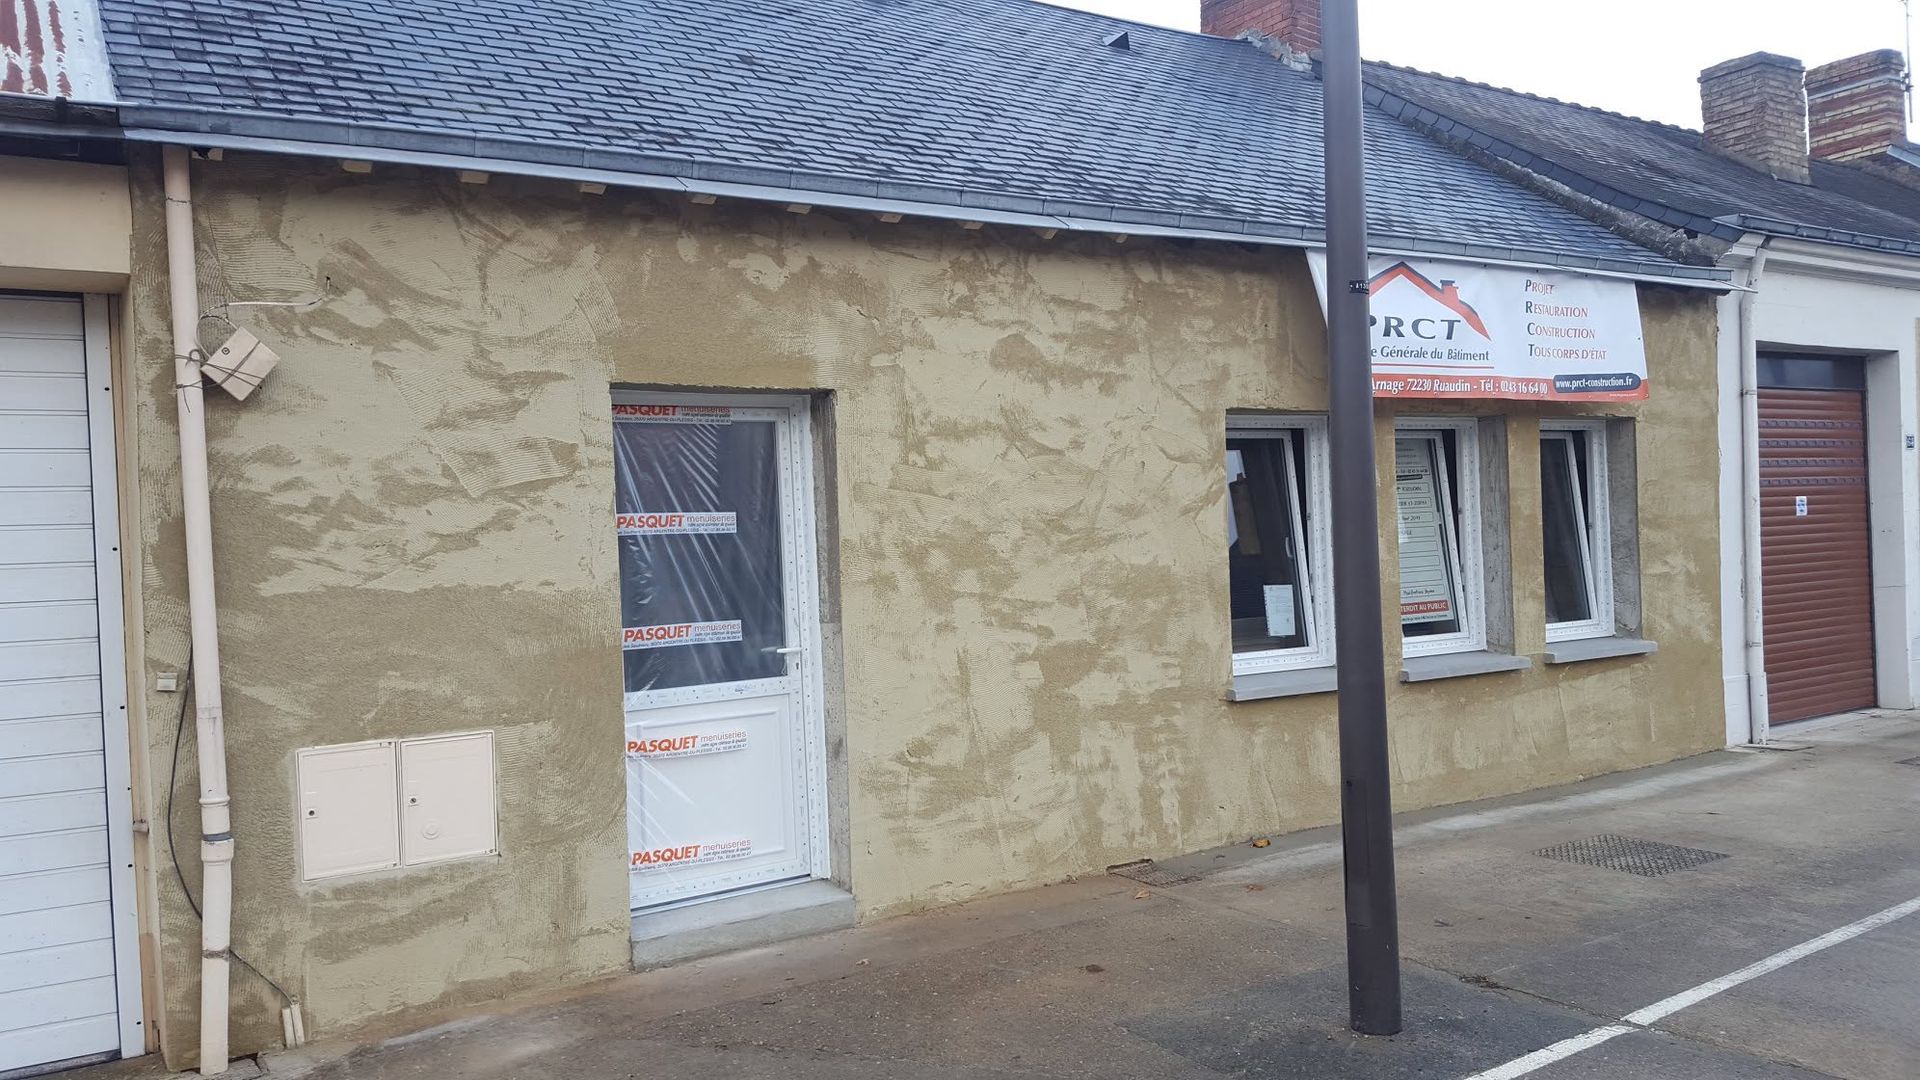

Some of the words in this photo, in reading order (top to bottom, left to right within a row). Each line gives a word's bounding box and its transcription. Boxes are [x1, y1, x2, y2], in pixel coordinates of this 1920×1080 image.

[1525, 279, 1554, 295] PROJET
[1525, 301, 1588, 317] RESTAURATION
[1527, 322, 1595, 339] CONSTRUCTION
[1380, 346, 1428, 359] Générale
[1431, 347, 1443, 359] du
[1447, 348, 1489, 361] Bâtiment
[1528, 344, 1550, 357] TOUS
[1552, 348, 1579, 359] CORPS
[1406, 378, 1431, 391] 72230
[1433, 379, 1470, 392] Ruaudin
[1555, 375, 1633, 390] www.prct-construction.fr
[616, 515, 684, 528] PASQUET
[687, 514, 735, 523] menuiseries
[623, 625, 692, 642] PASQUET
[694, 623, 740, 632] menuiseries
[627, 735, 698, 753] PASQUET
[700, 730, 746, 742] menuiseries
[631, 845, 701, 865] PASQUET
[703, 839, 751, 852] menuiseries
